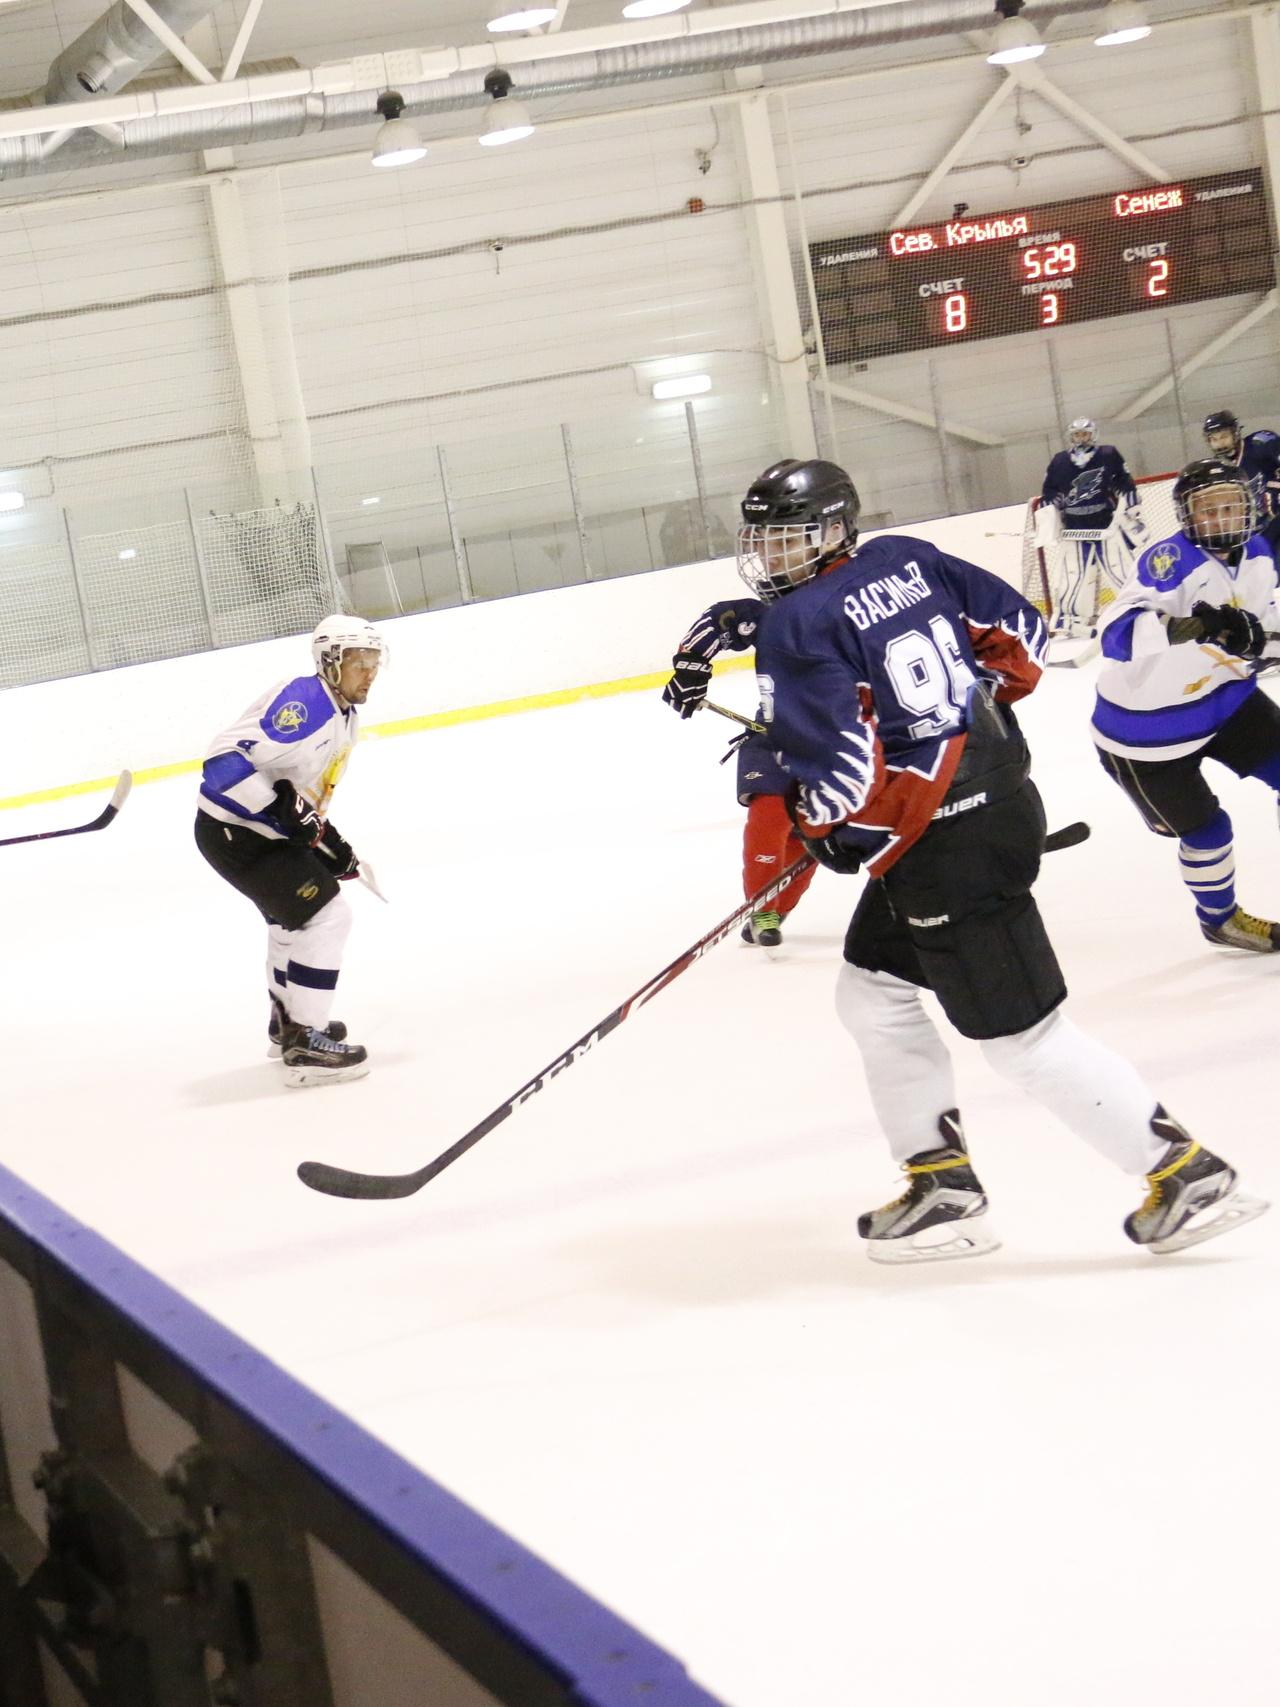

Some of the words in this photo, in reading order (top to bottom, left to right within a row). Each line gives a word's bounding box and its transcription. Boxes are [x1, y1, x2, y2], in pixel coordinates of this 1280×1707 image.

[1115, 189, 1183, 217] Сенеж
[889, 232, 938, 256] Сев.
[945, 216, 1028, 246] Крылья
[1018, 232, 1061, 248] ВРЕМЯ
[820, 248, 879, 266] УДАЛЕНИЯ
[1123, 242, 1170, 262] СЧЕТ
[919, 277, 965, 298] СЧЕТ
[1022, 277, 1074, 296] ПЕРИОД
[1148, 259, 1169, 297] 2
[945, 295, 967, 332] 8
[1042, 294, 1058, 324] 3
[822, 500, 844, 514] CCM
[883, 614, 977, 740] 96
[931, 791, 988, 821] AUER
[687, 874, 793, 968] JETSPEED
